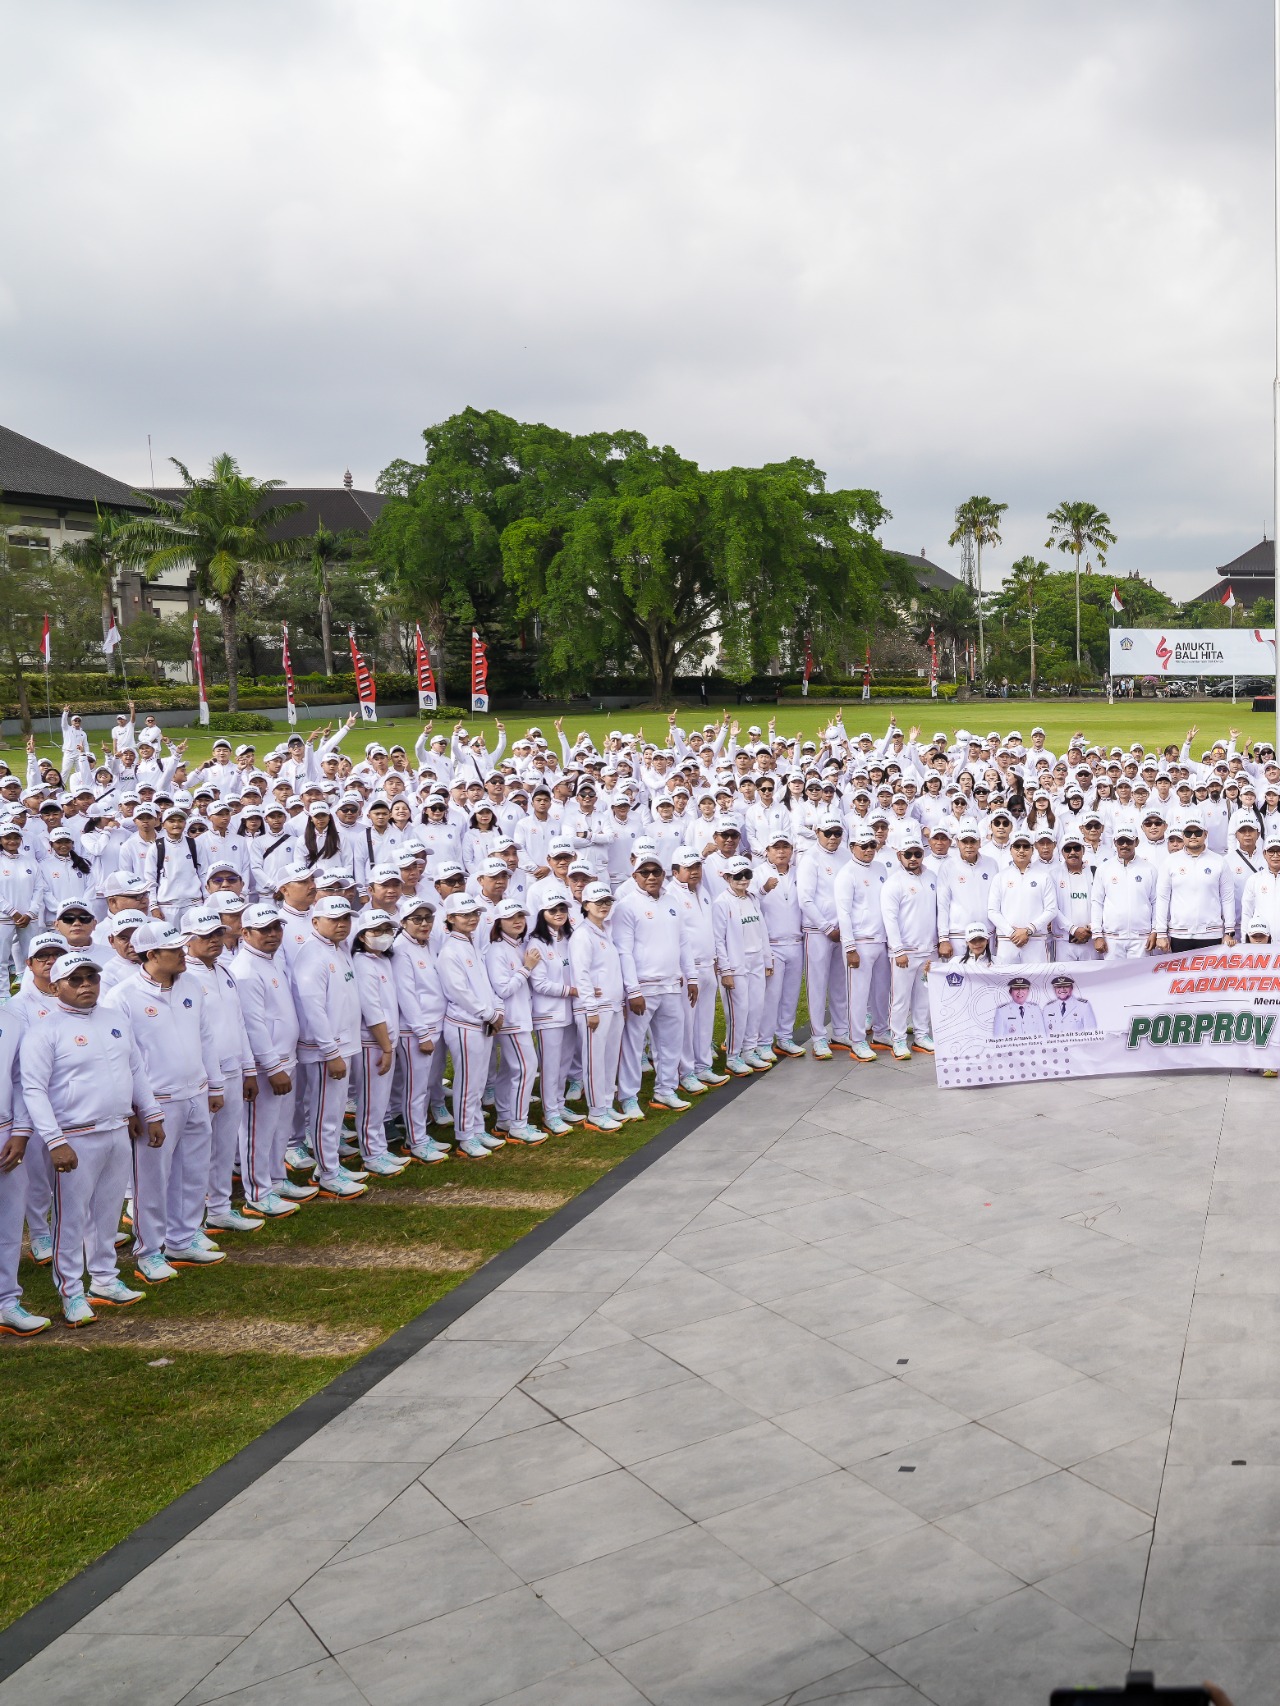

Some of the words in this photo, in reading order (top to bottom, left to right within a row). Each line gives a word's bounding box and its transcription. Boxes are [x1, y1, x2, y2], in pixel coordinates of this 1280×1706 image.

[1175, 651, 1198, 659] BALI
[1201, 651, 1224, 659] HITA
[1153, 954, 1270, 973] PELEPASAN
[1127, 1010, 1277, 1049] PORPROV
